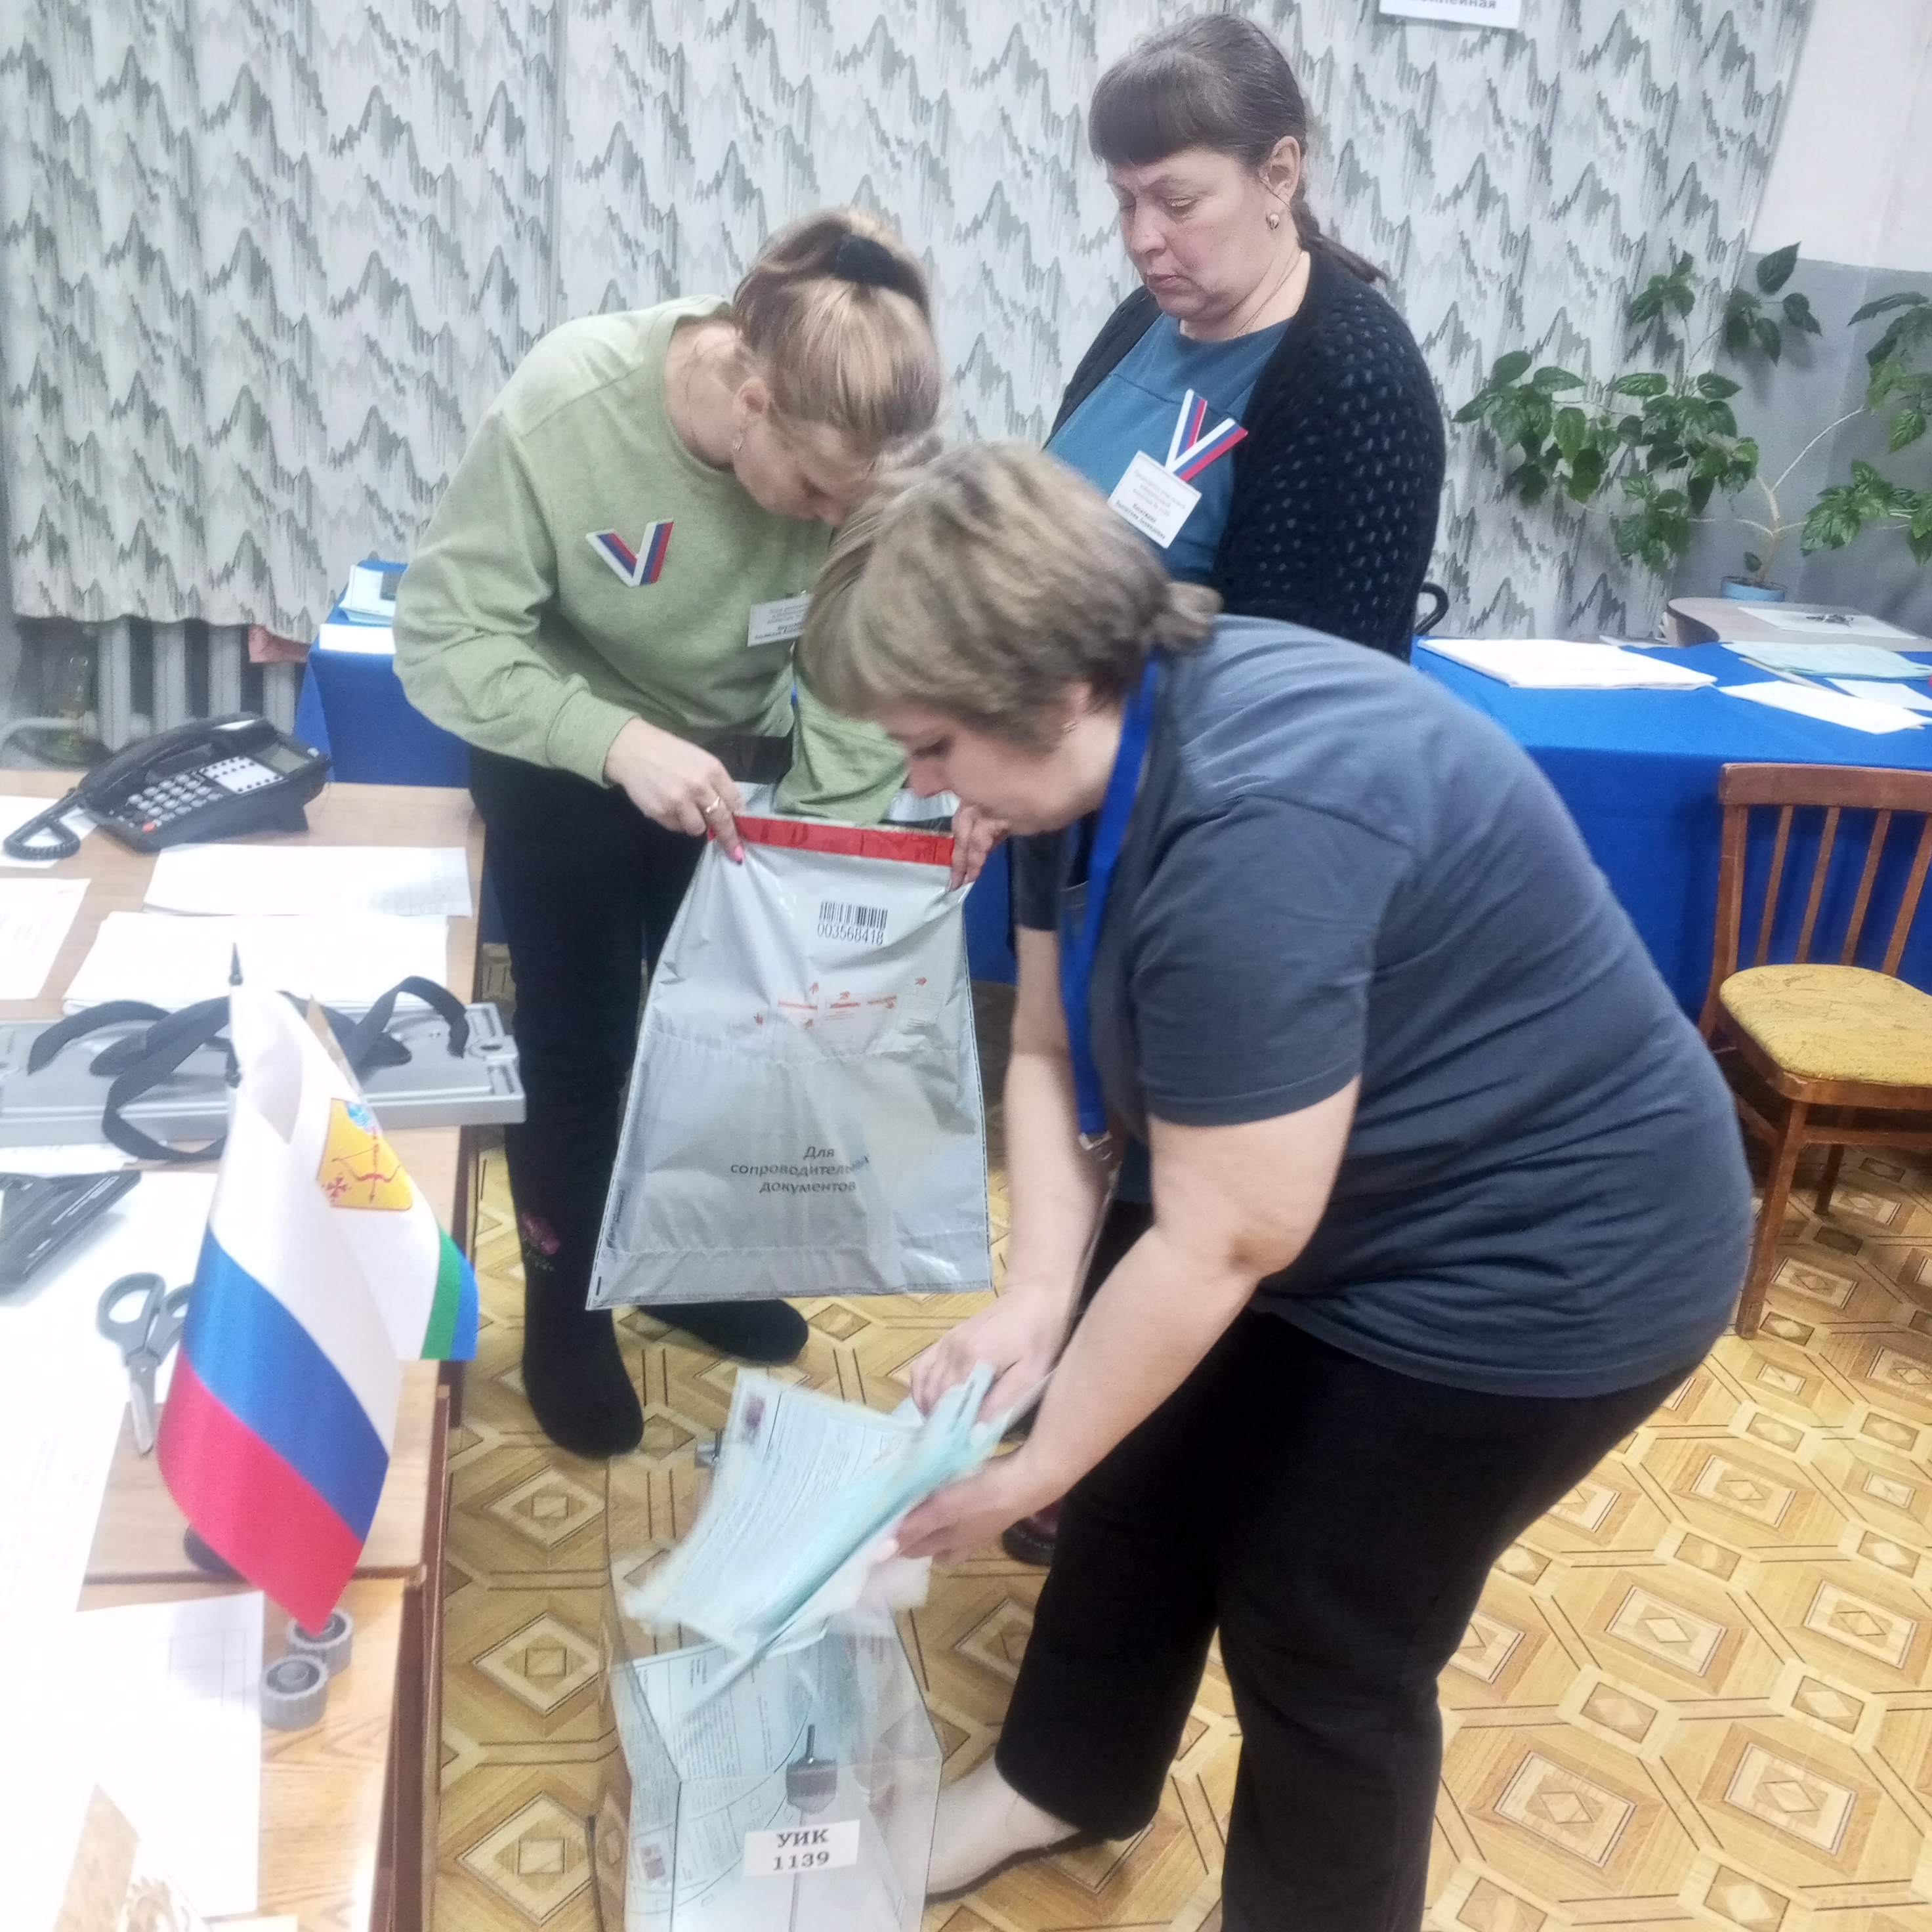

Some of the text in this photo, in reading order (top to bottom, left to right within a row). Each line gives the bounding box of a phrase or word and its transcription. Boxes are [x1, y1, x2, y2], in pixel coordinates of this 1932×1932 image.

[817, 923, 884, 946] 003568418
[803, 1146, 834, 1160] Для
[759, 1181, 856, 1194] документов
[776, 1828, 830, 1848] УИК
[773, 1851, 830, 1871] 1139
